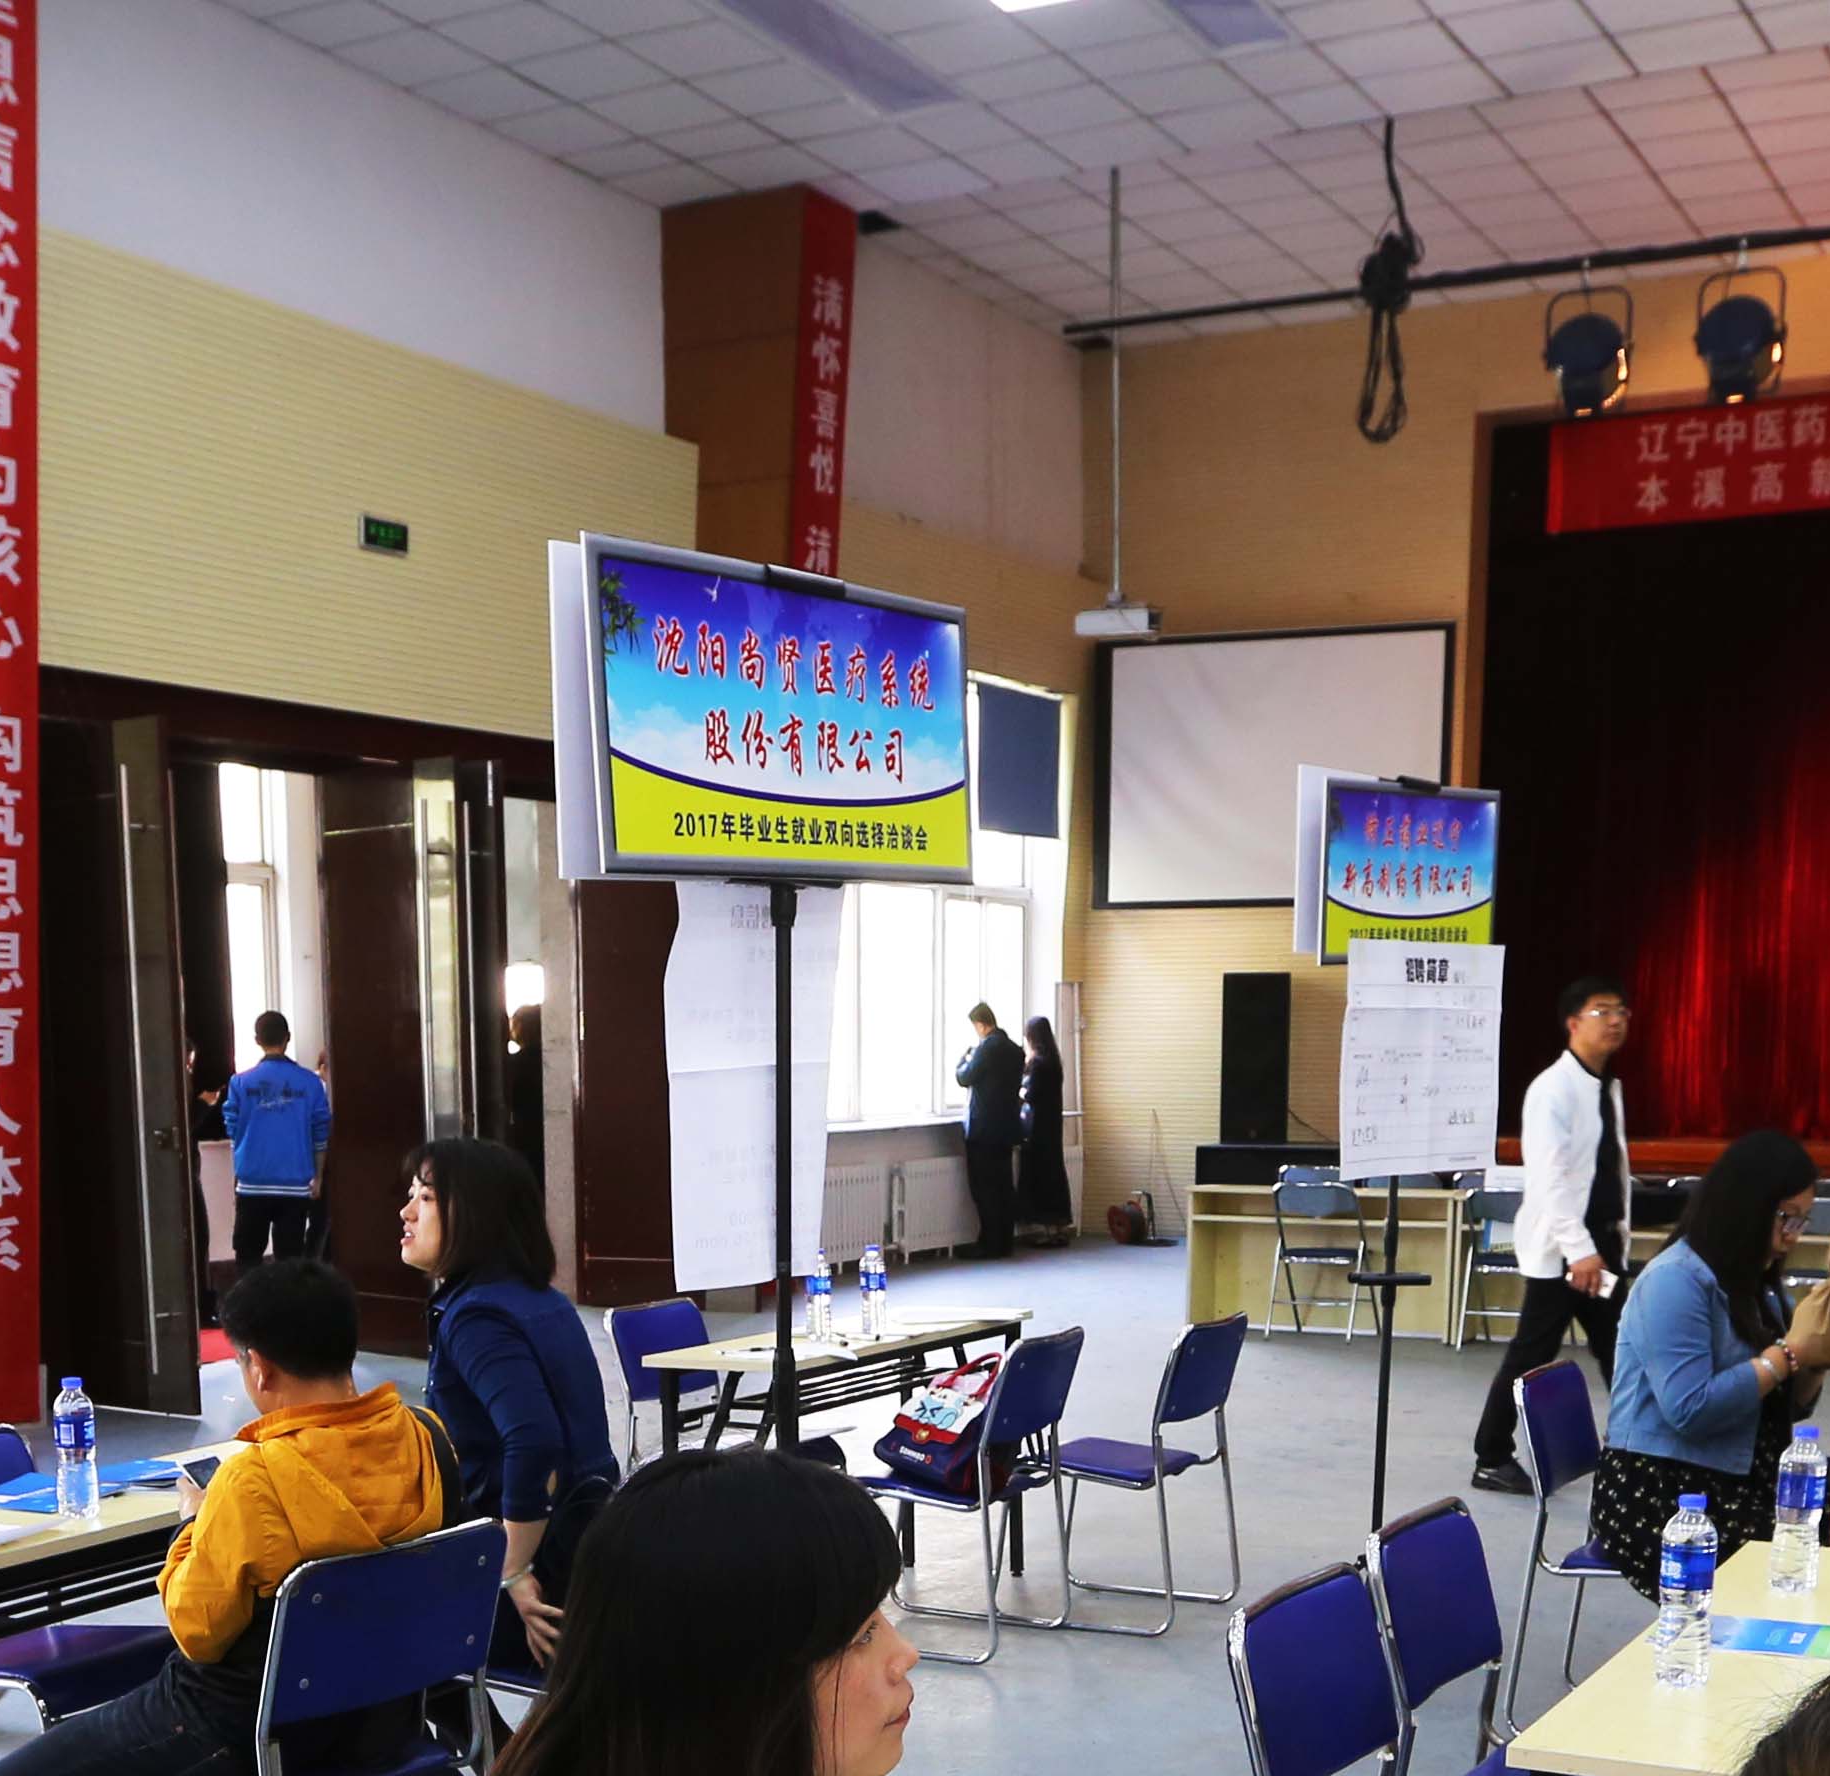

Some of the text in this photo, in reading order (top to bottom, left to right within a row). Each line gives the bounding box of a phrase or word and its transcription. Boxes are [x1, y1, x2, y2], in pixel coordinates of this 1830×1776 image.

[653, 615, 935, 712] 沈阳尚贤医疗系统
[704, 709, 908, 783] 股份有限公司
[673, 811, 929, 852] 2017年毕业生就业双向选择洽谈会
